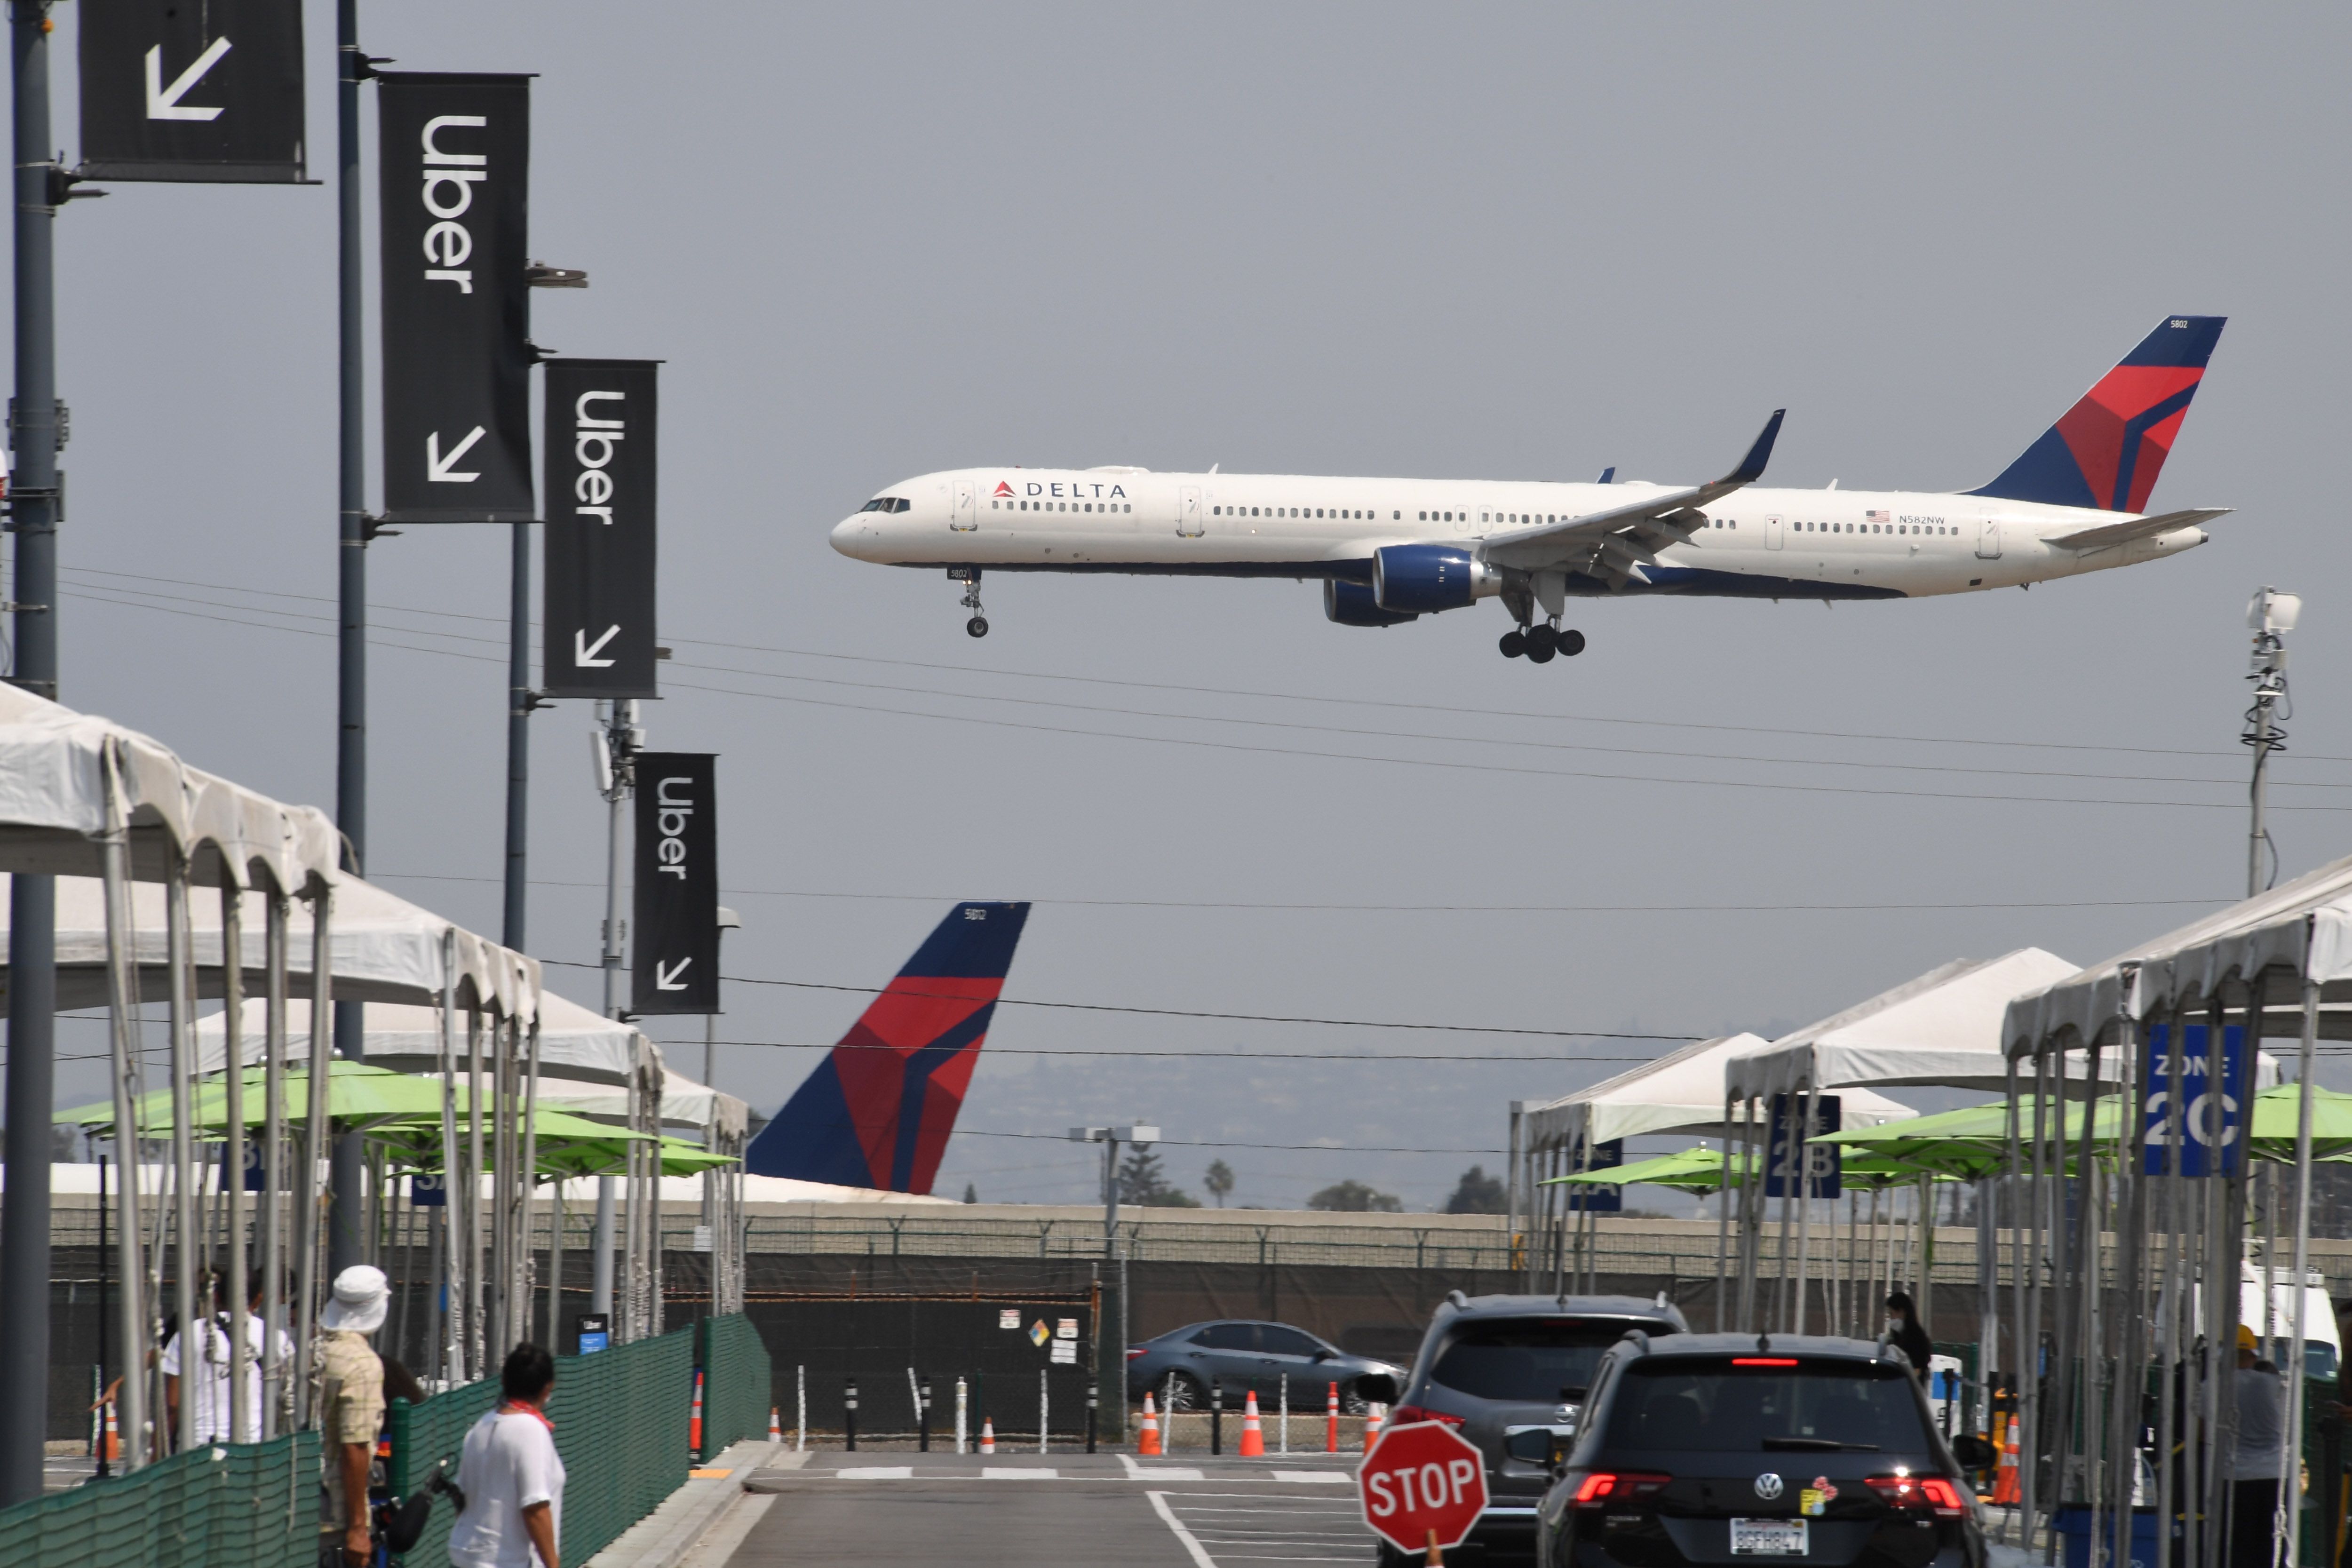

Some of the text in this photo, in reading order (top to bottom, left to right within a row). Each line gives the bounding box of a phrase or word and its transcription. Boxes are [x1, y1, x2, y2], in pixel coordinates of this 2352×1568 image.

[421, 115, 487, 294] Uber
[2171, 320, 2188, 328] 5802
[575, 390, 625, 525] Uber
[1027, 483, 1126, 498] DELTA
[1899, 515, 1945, 525] N582NW
[951, 569, 968, 578] 5802
[659, 777, 692, 880] Uber
[2144, 1091, 2240, 1147] 2C
[1369, 1458, 1475, 1517] STOP
